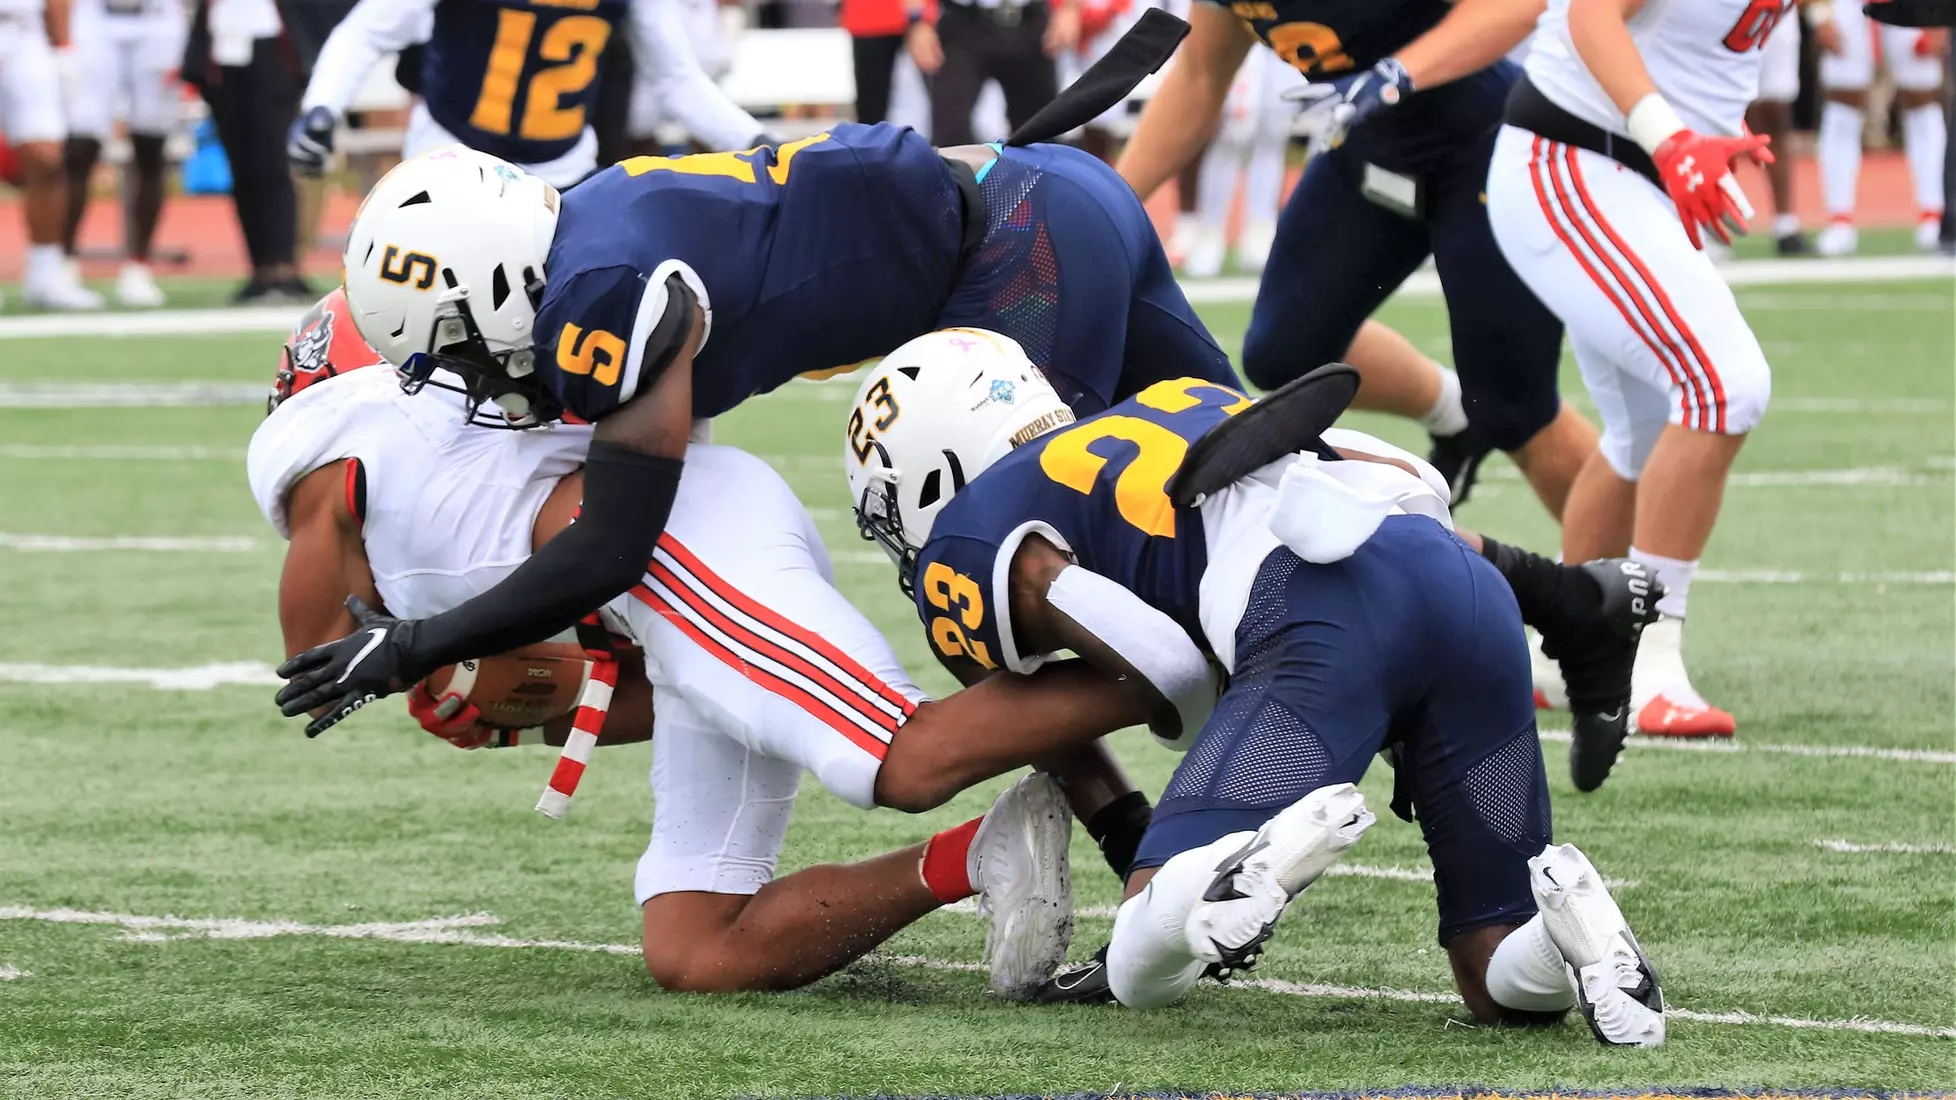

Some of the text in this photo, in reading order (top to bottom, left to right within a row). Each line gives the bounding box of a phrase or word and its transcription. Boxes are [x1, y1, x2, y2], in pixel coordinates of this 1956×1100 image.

[469, 8, 611, 140] 12
[847, 376, 901, 466] 23
[1008, 412, 1056, 450] MURRAY
[923, 561, 998, 670] 23
